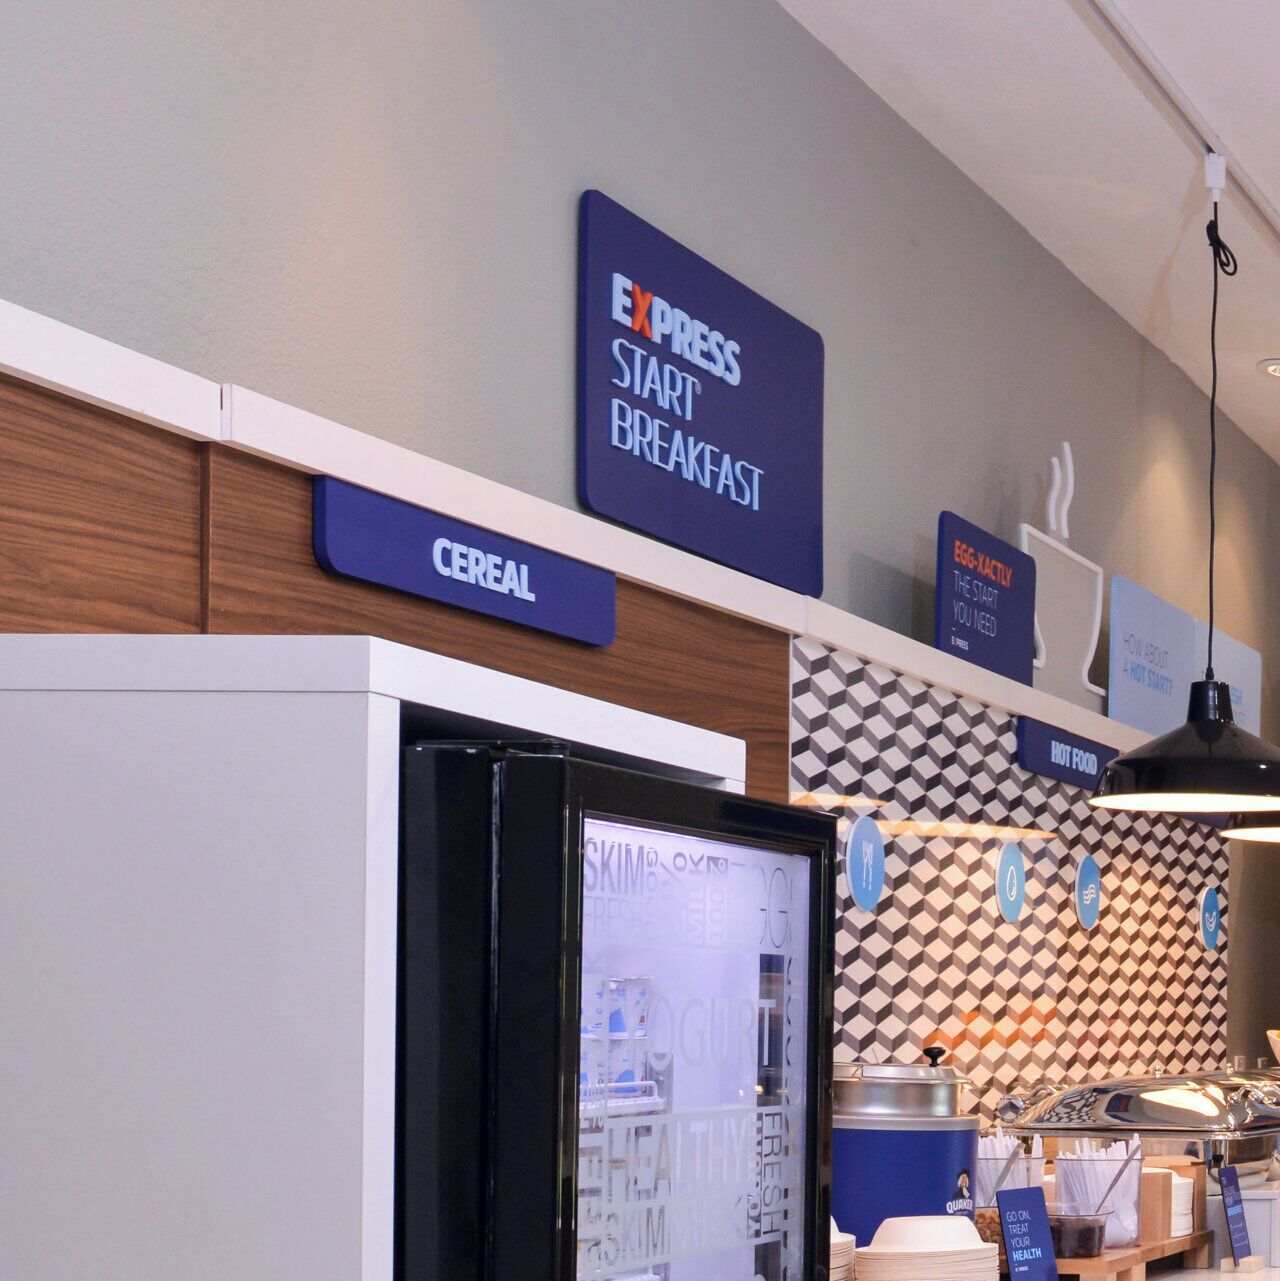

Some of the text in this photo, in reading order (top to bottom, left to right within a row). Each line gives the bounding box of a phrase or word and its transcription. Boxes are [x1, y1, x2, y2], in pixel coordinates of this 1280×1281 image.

[612, 273, 741, 386] EXPRESS
[611, 398, 764, 510] BREAKFAST
[433, 537, 536, 602] CEREAL
[954, 540, 1013, 588] EGG-XACTLY
[953, 570, 998, 610] THE START
[953, 600, 997, 637] YOU NEED
[1123, 632, 1169, 669] HOW ABOUT
[1123, 659, 1174, 697] A HOT START?
[1051, 740, 1097, 776] HOT FOOD
[585, 838, 644, 896] SKIM
[626, 994, 777, 1071] OGURT
[763, 1112, 783, 1236] FRESH
[1006, 1211, 1017, 1222] GO
[1008, 1223, 1029, 1235] TREAT
[1010, 1236, 1030, 1248] YOUR
[1013, 1248, 1042, 1261] HEALTH
